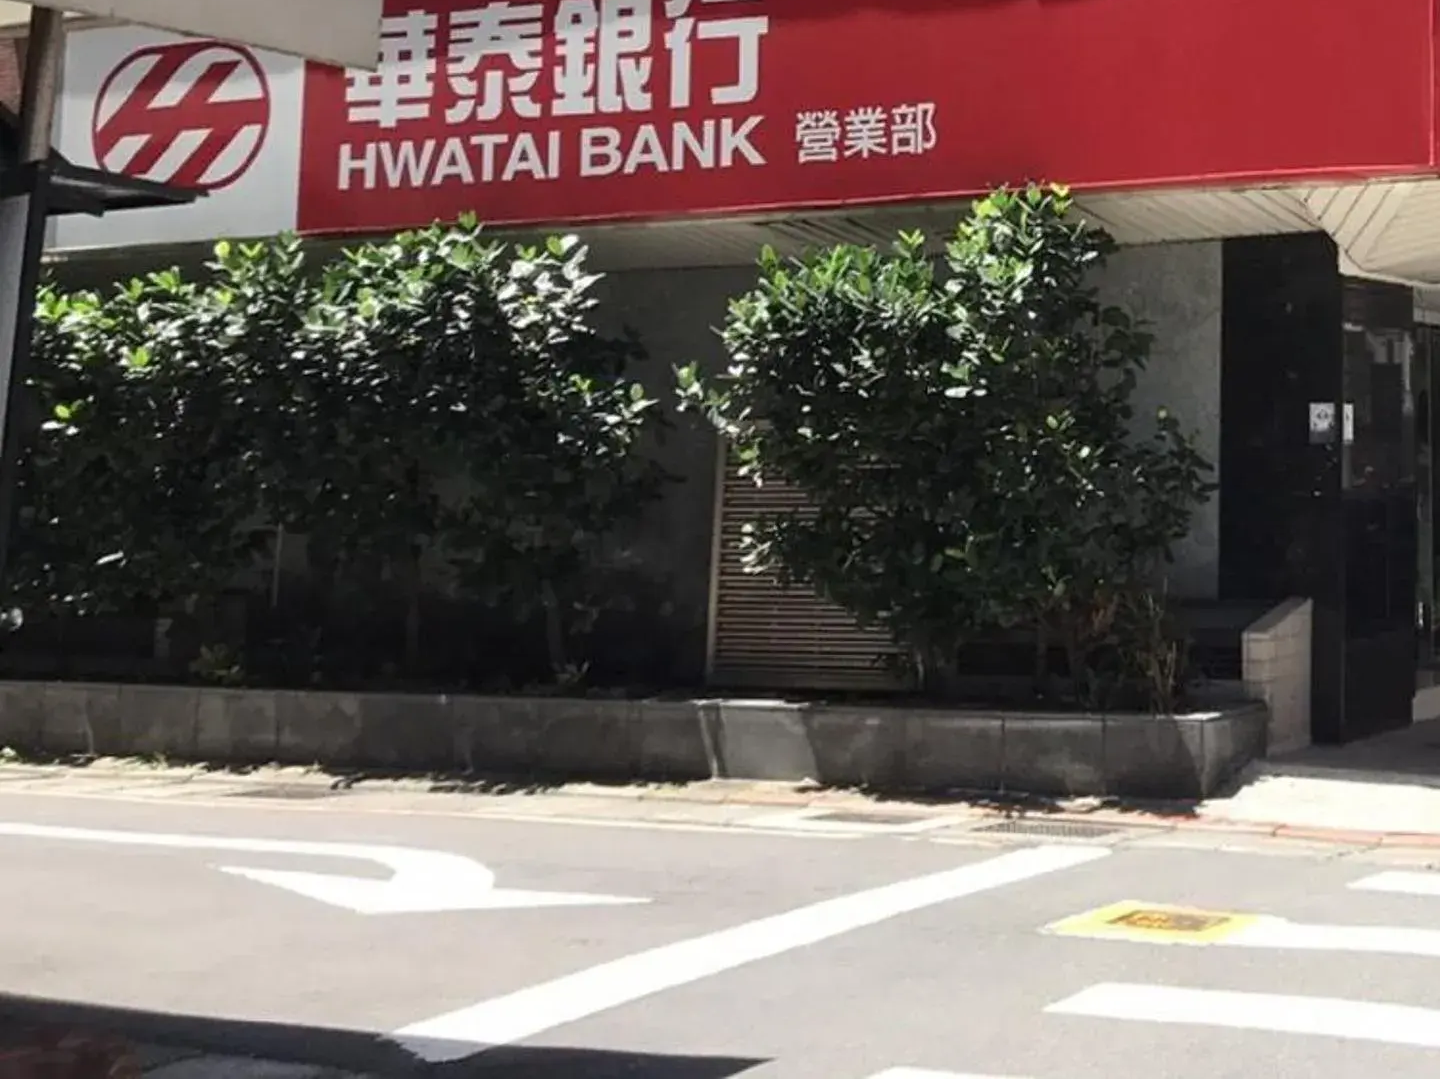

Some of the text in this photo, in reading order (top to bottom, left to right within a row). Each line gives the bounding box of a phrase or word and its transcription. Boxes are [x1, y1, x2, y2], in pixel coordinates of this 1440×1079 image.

[337, 115, 767, 191] HWATAI BANK
[795, 102, 937, 164] 營業部
